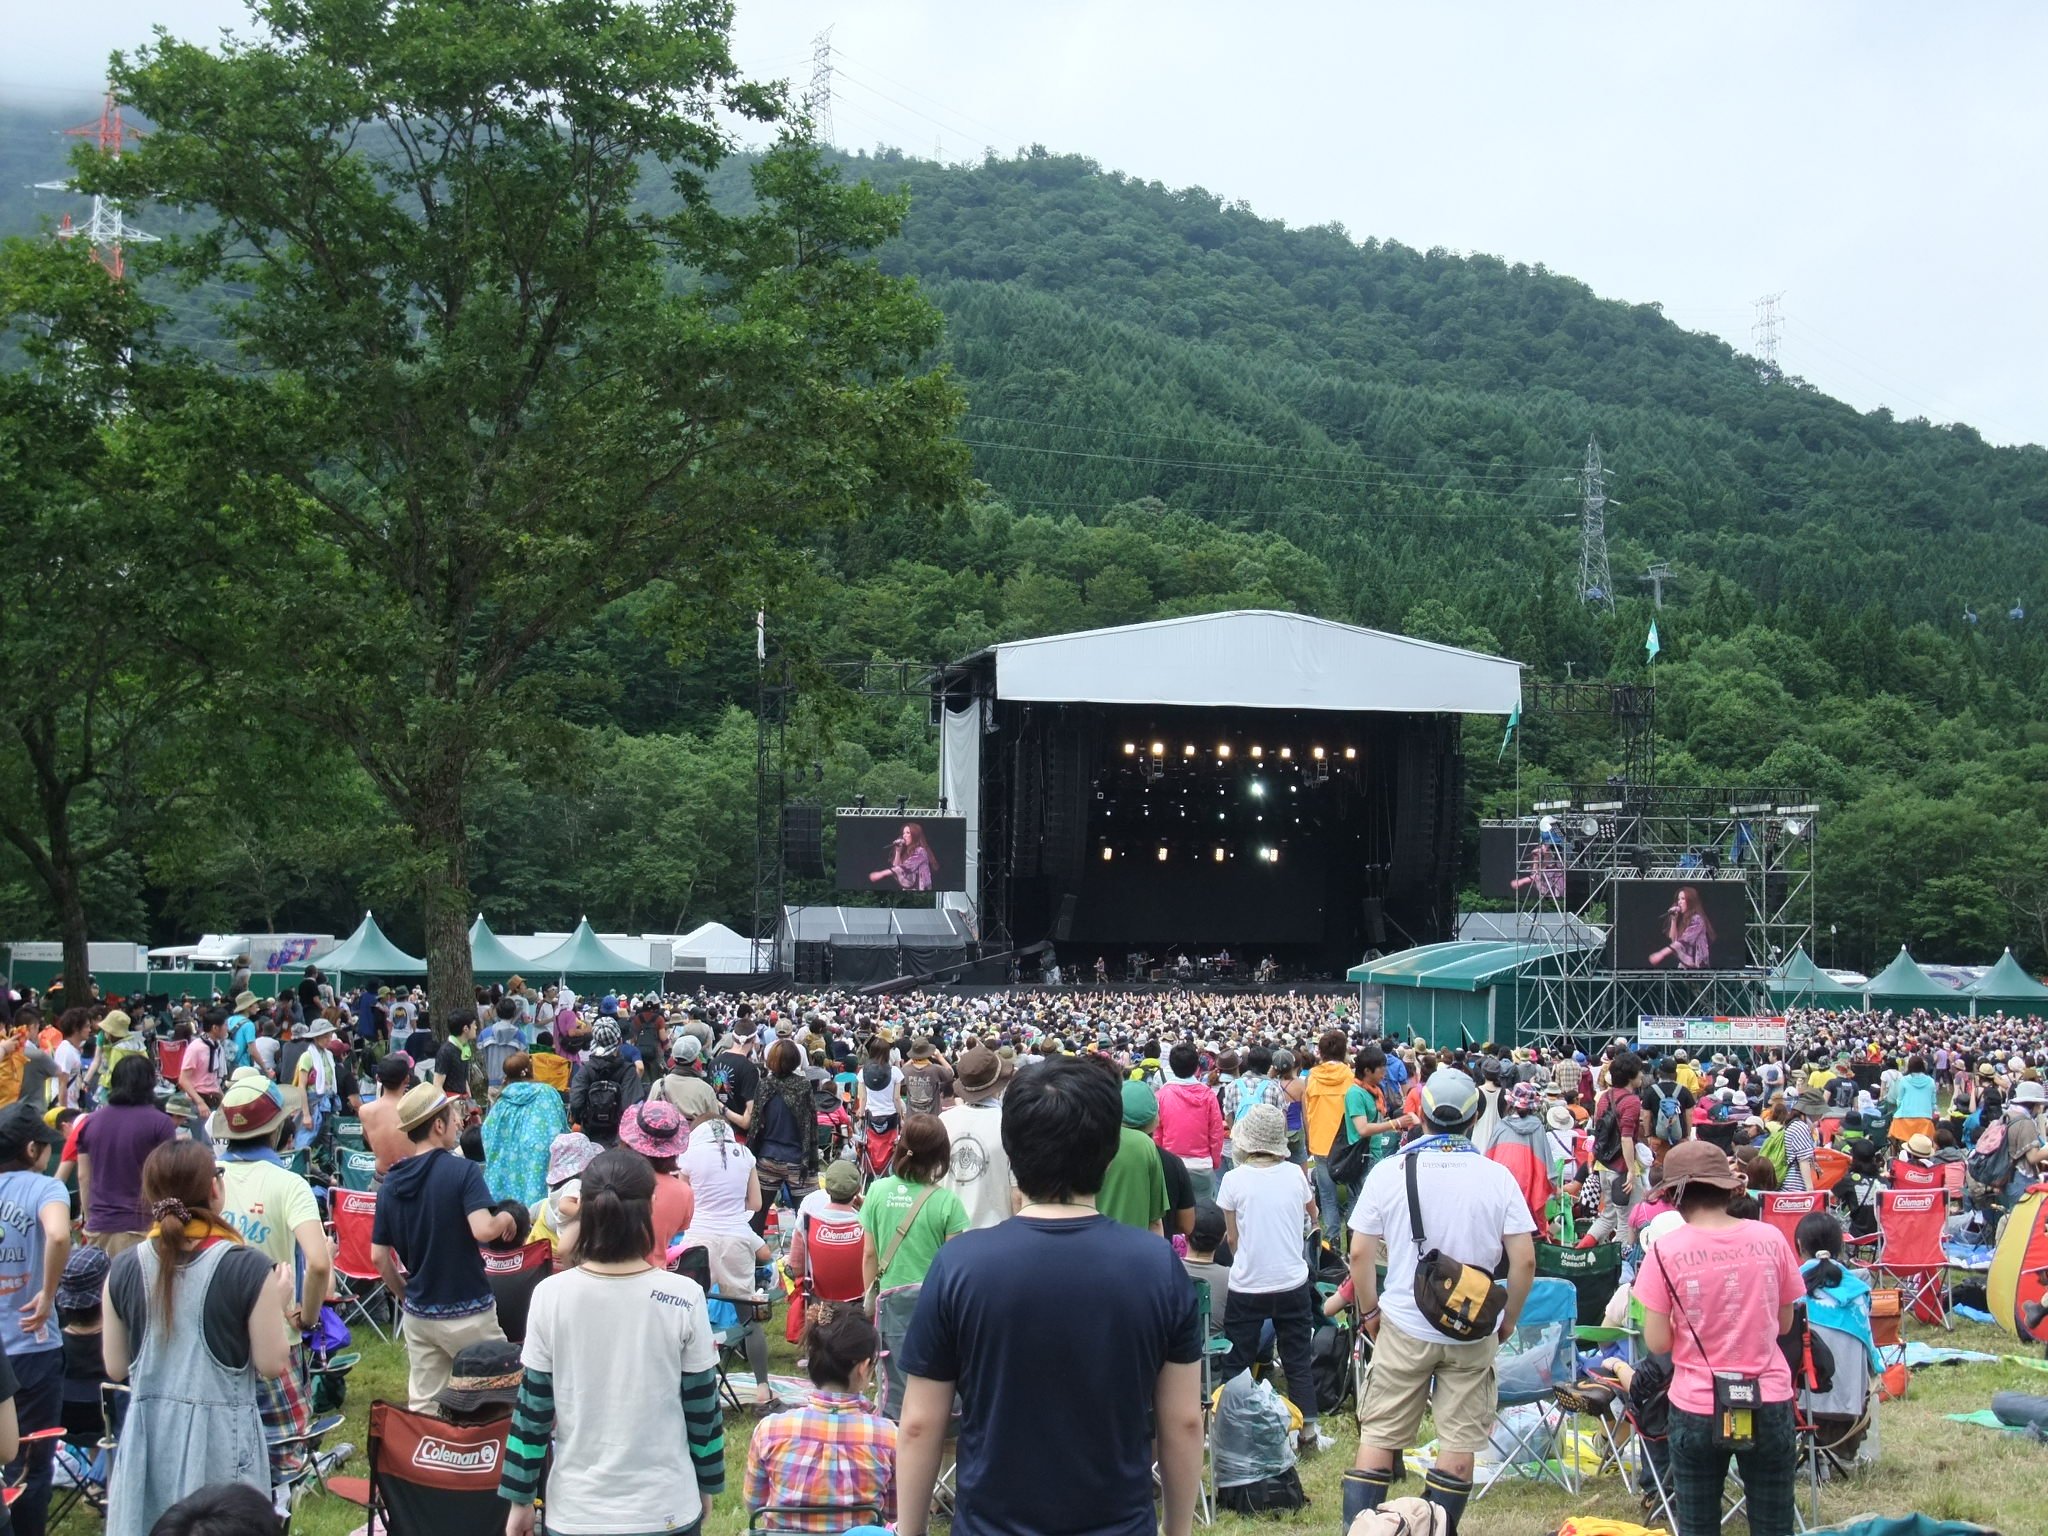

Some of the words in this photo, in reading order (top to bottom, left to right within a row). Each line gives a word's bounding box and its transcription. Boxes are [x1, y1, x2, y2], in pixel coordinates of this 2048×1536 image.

[1776, 1200, 1804, 1208] Coleman
[1897, 1198, 1925, 1207] Coleman
[820, 1227, 854, 1240] Coleman
[1560, 1252, 1586, 1261] Natural
[1674, 1249, 1708, 1270] FUJI
[1711, 1248, 1744, 1262] ROCK
[1745, 1241, 1778, 1258] 2007
[1561, 1260, 1586, 1268] Season
[650, 1290, 694, 1311] FORTUNE
[421, 1440, 480, 1465] Coleman
